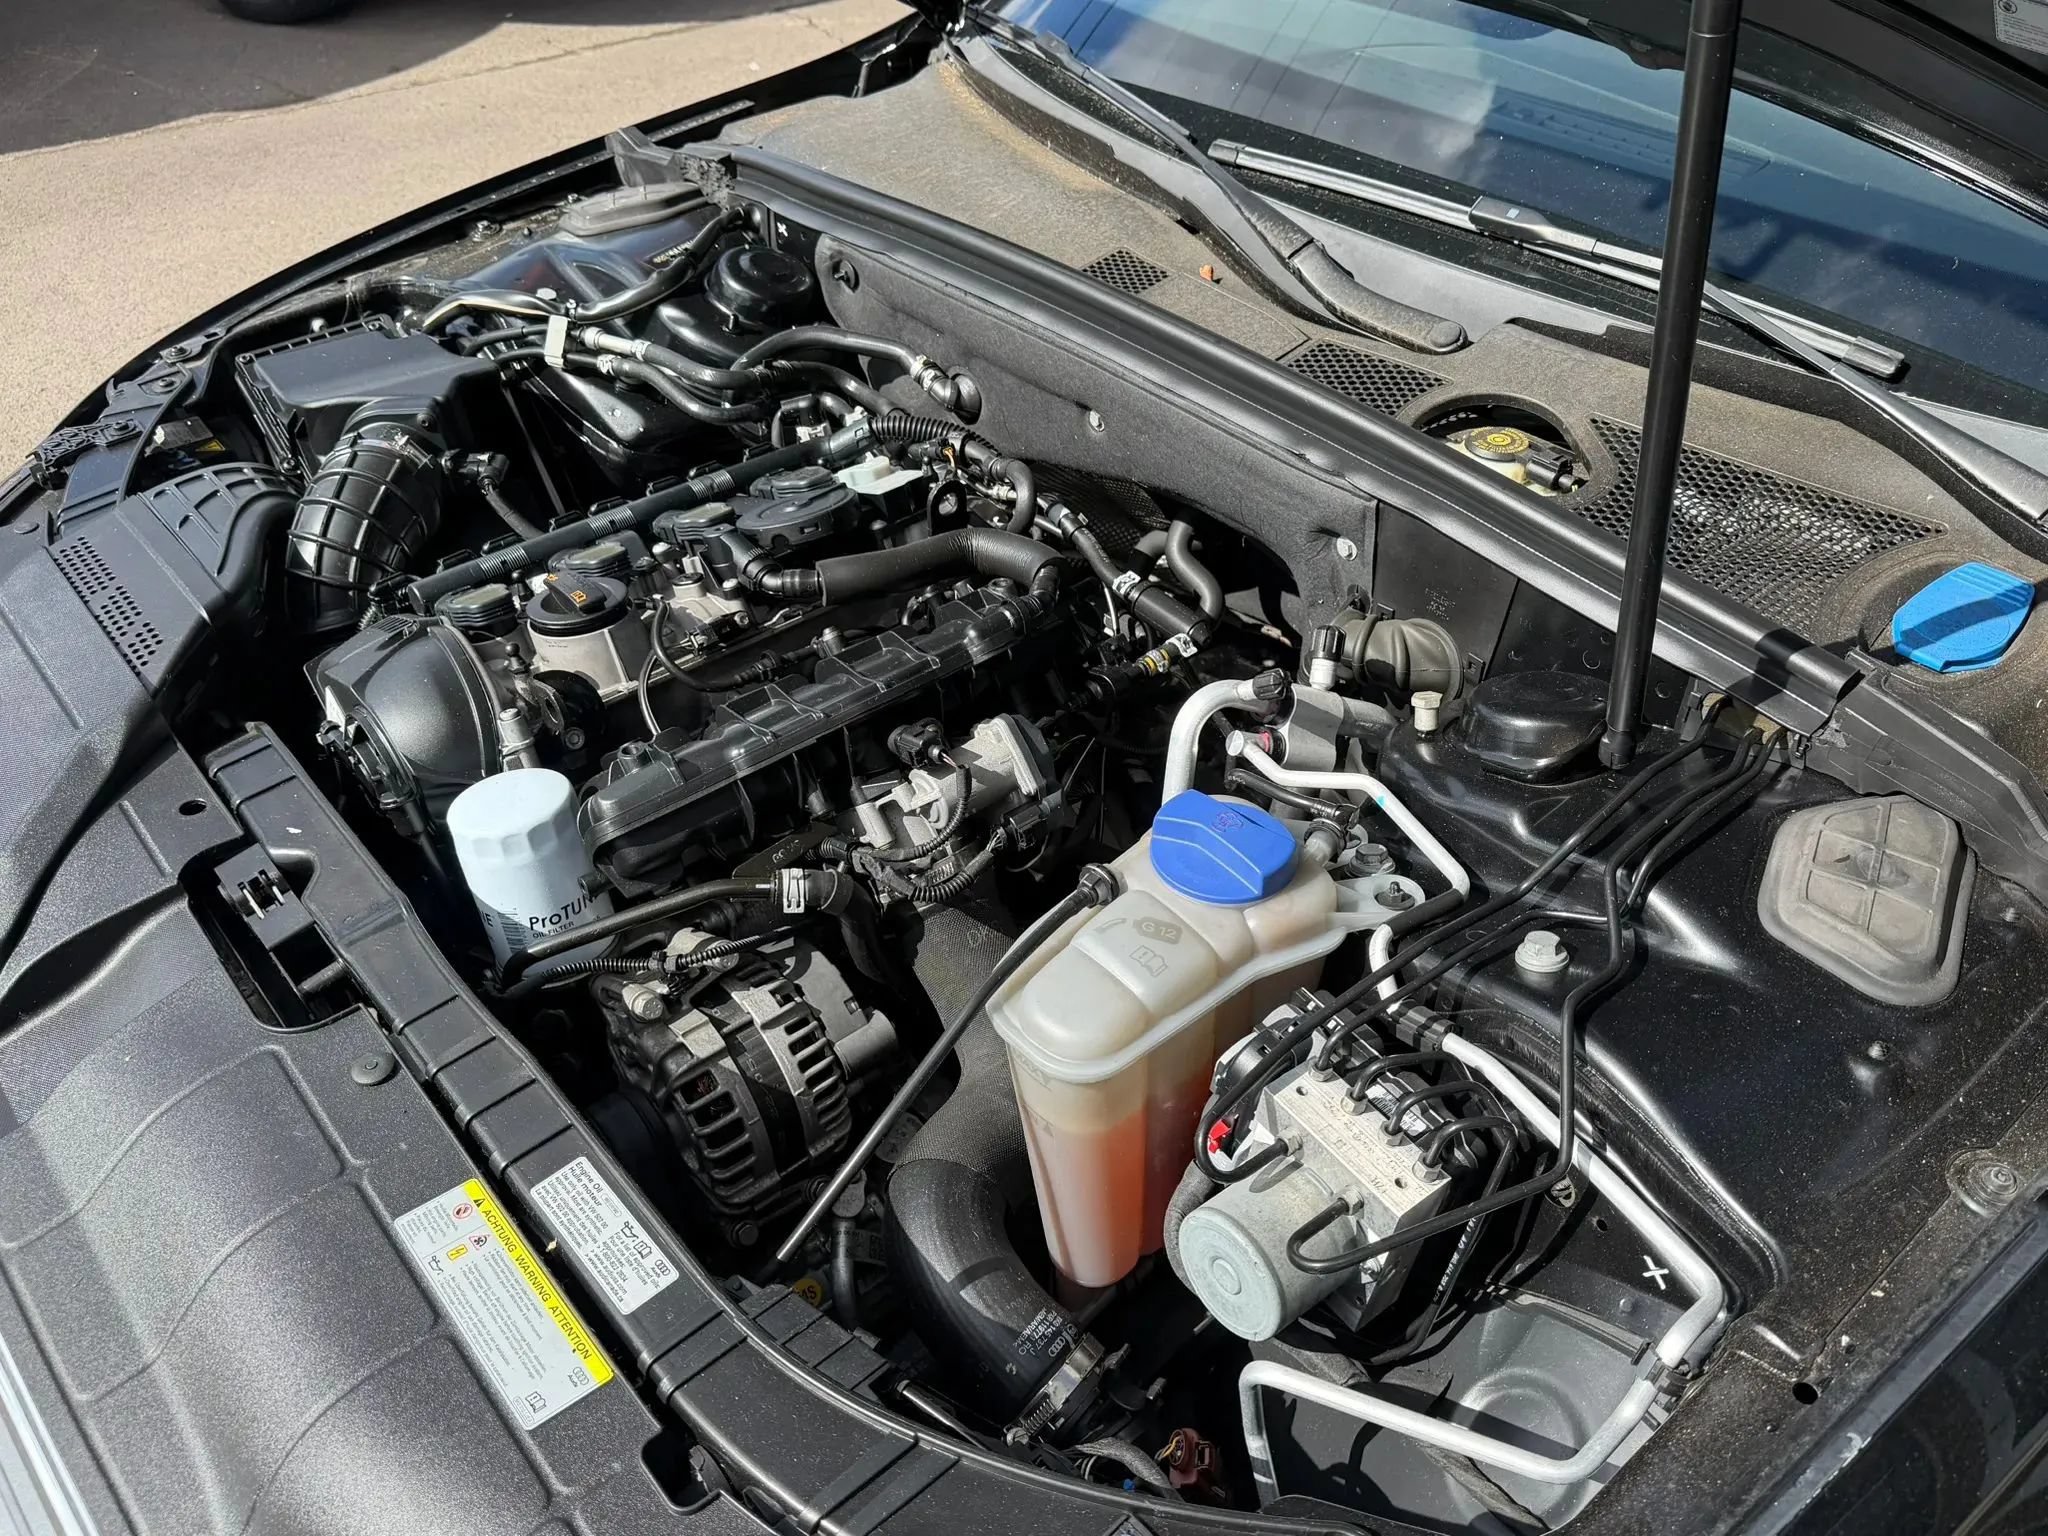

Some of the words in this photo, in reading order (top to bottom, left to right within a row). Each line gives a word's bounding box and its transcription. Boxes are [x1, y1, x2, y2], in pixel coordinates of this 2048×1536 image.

[529, 894, 596, 930] ProTUN
[533, 931, 546, 939] OIL
[548, 921, 574, 936] FILTER
[1142, 922, 1154, 932] G
[1159, 926, 1176, 939] 12
[567, 1166, 584, 1183] Huile
[580, 1182, 602, 1207] moteur
[575, 1161, 595, 1184] Engine
[591, 1182, 603, 1193] Oil
[560, 1171, 570, 1181] Use
[567, 1179, 578, 1190] only
[579, 1195, 590, 1206] with
[587, 1205, 597, 1215] VW
[569, 1194, 582, 1208] Most
[607, 1235, 619, 1248] Pour
[613, 1231, 623, 1241] For
[632, 1256, 653, 1279] approved
[481, 1208, 518, 1253] ACHTUNG
[513, 1253, 553, 1303] WARNING
[547, 1303, 593, 1360] ATTENTION
[1044, 1325, 1056, 1337] 145
[567, 1373, 579, 1387] Audi
